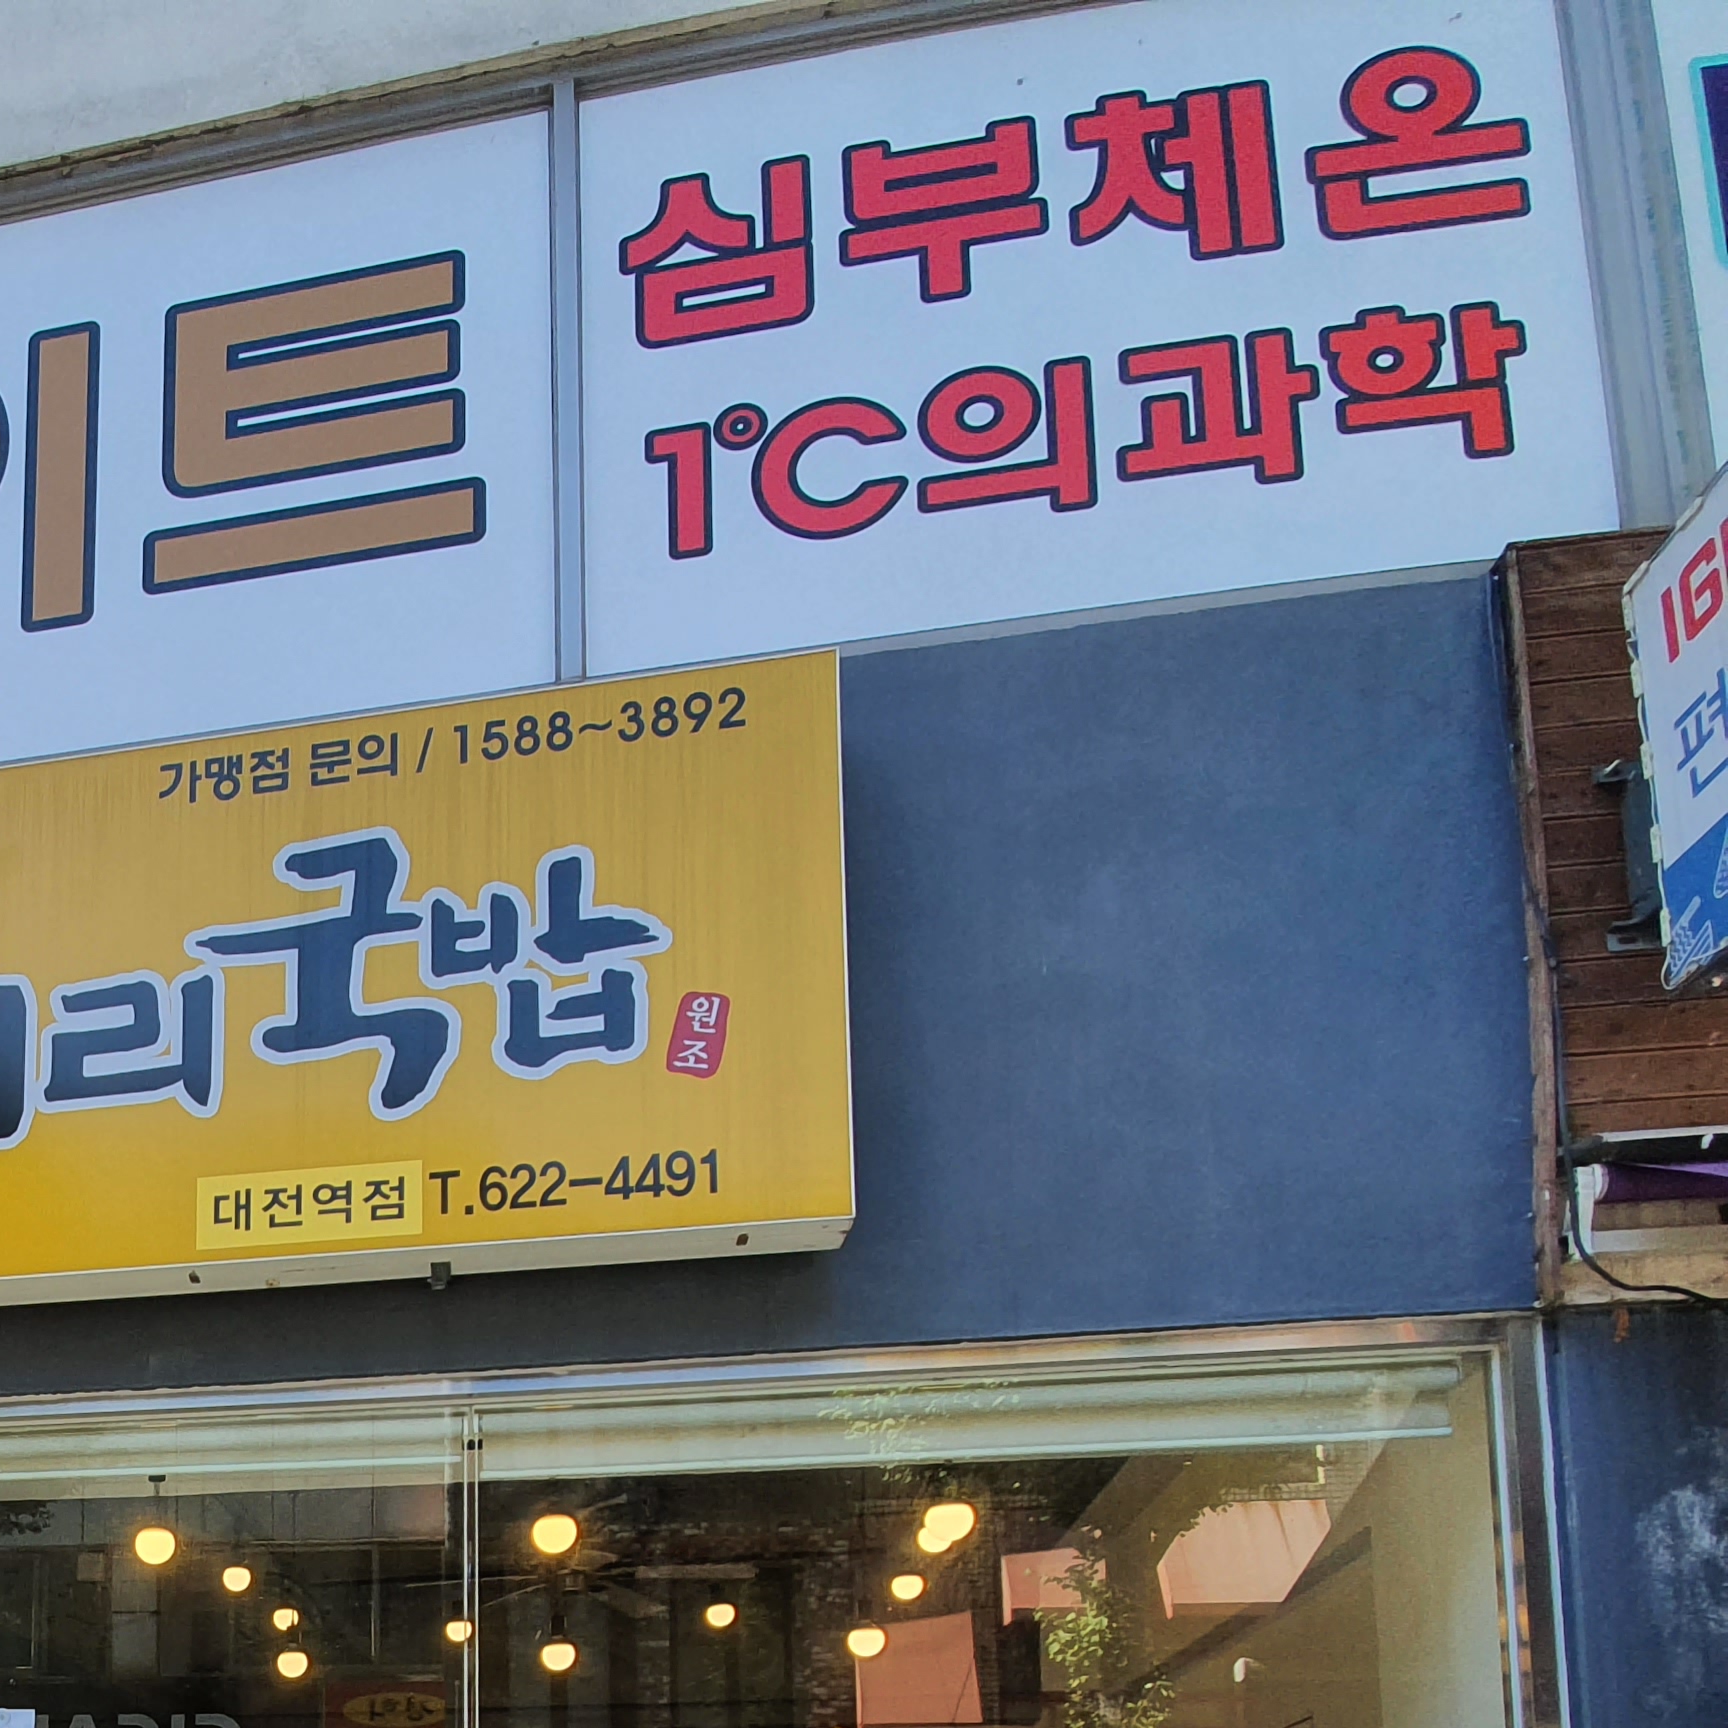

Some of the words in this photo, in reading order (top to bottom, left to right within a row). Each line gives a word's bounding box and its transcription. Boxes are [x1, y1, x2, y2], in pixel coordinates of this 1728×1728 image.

[616, 45, 1532, 350] 심부체온
[159, 745, 292, 804] 가맹점
[308, 731, 402, 785] 문의
[450, 686, 748, 766] 1588~3892
[683, 995, 725, 1073] 원조
[212, 1174, 409, 1234] 대전역점
[428, 1147, 723, 1220] T.622-4491
